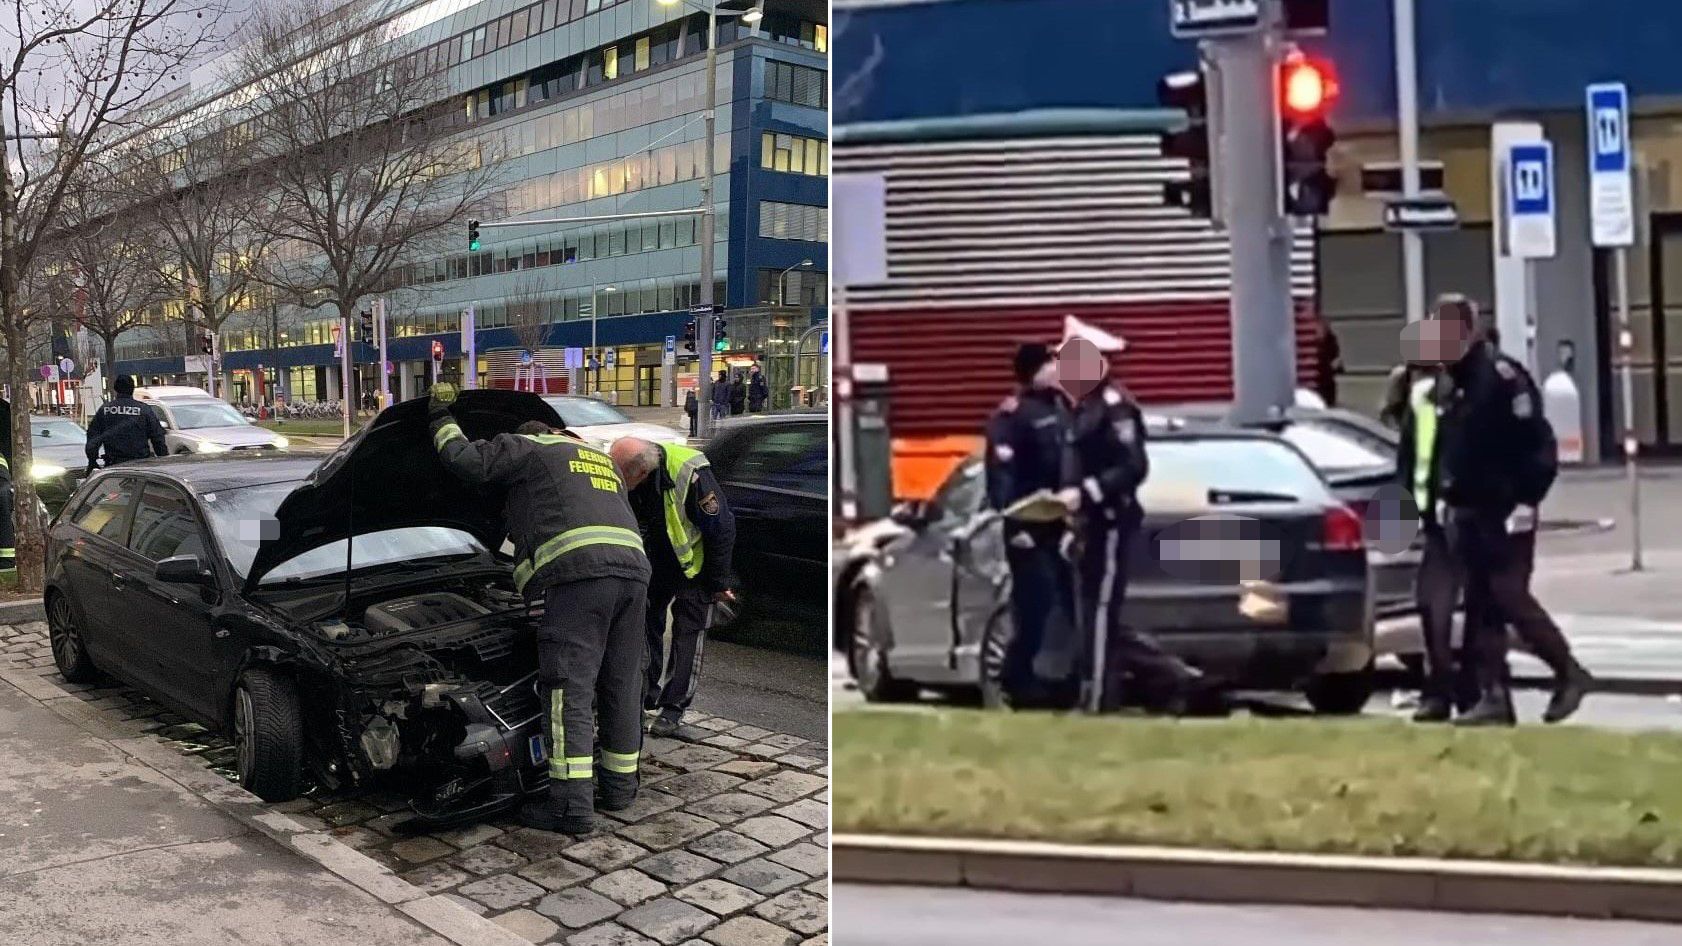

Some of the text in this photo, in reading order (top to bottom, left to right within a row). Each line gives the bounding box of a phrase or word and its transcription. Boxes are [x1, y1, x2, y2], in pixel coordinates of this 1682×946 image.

[103, 405, 141, 415] POLIZEI
[569, 460, 621, 485] FEUERW
[590, 476, 617, 493] WIEN
